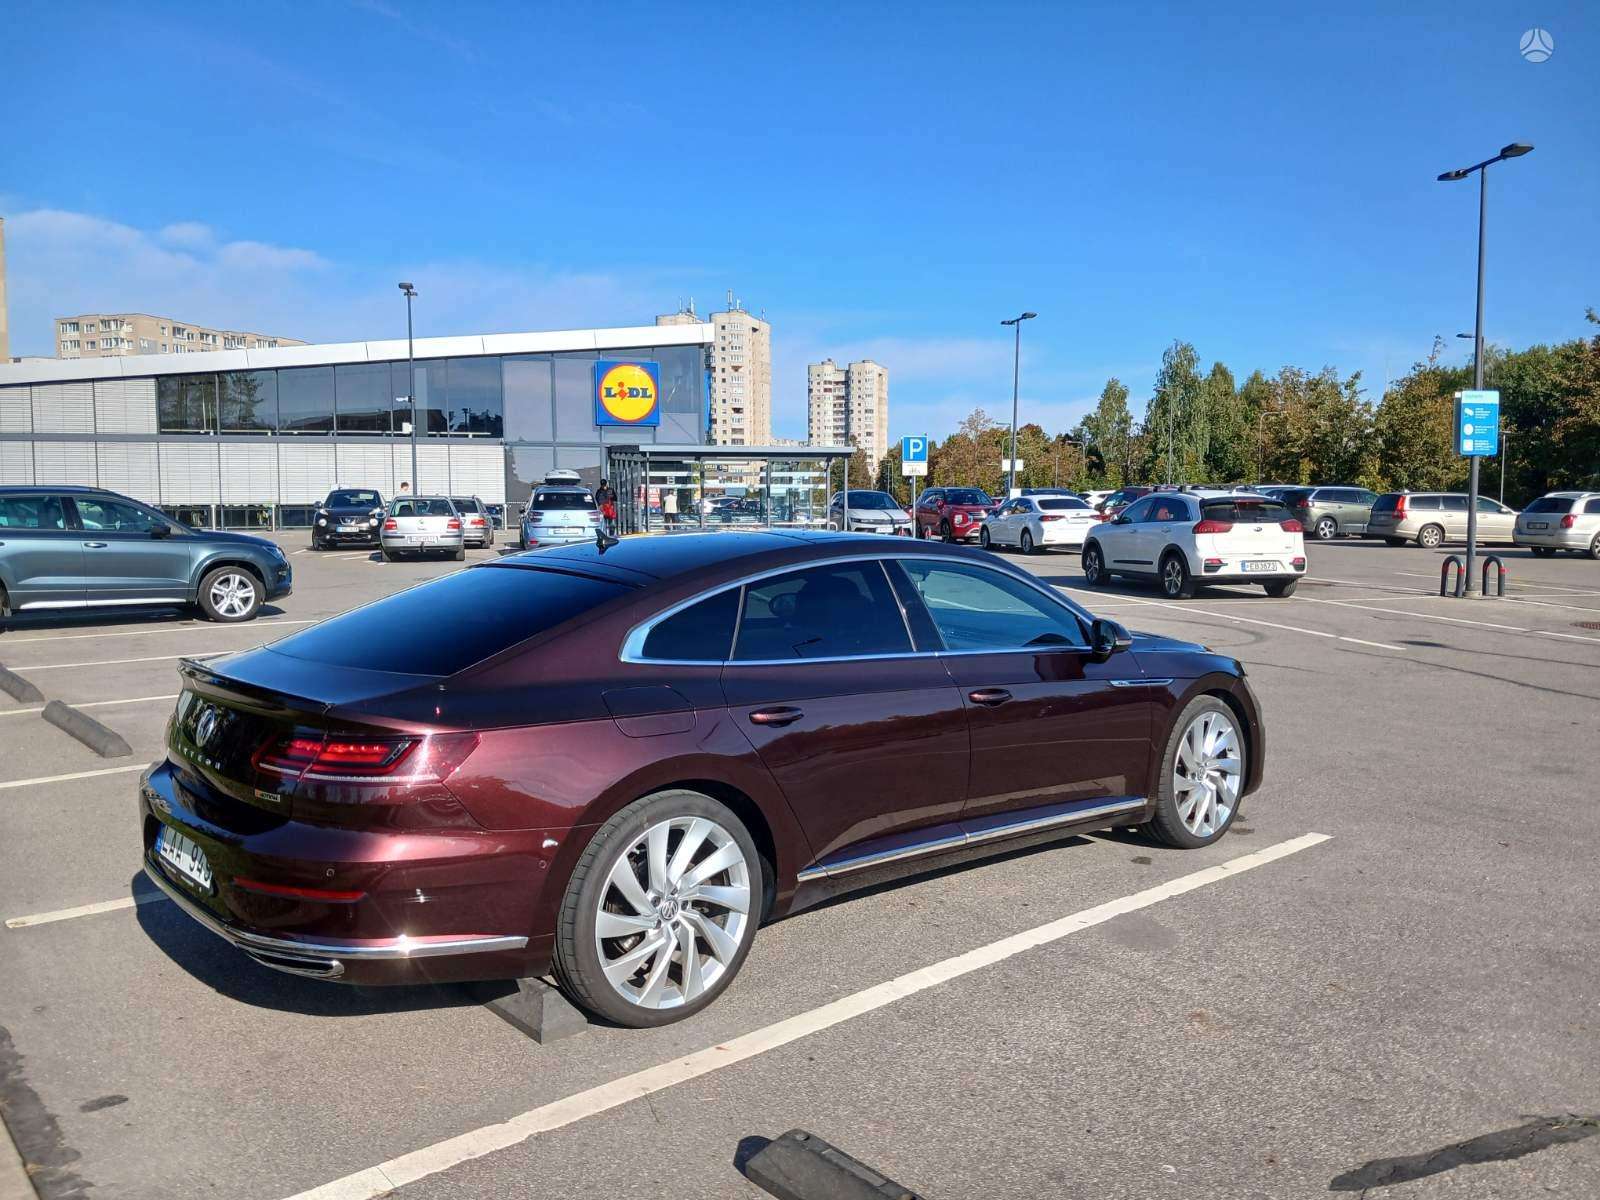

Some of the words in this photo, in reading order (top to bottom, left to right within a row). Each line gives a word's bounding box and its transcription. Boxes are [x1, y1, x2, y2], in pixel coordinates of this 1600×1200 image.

[604, 381, 652, 400] LIDL
[909, 438, 923, 460] P
[162, 825, 184, 865] LAA
